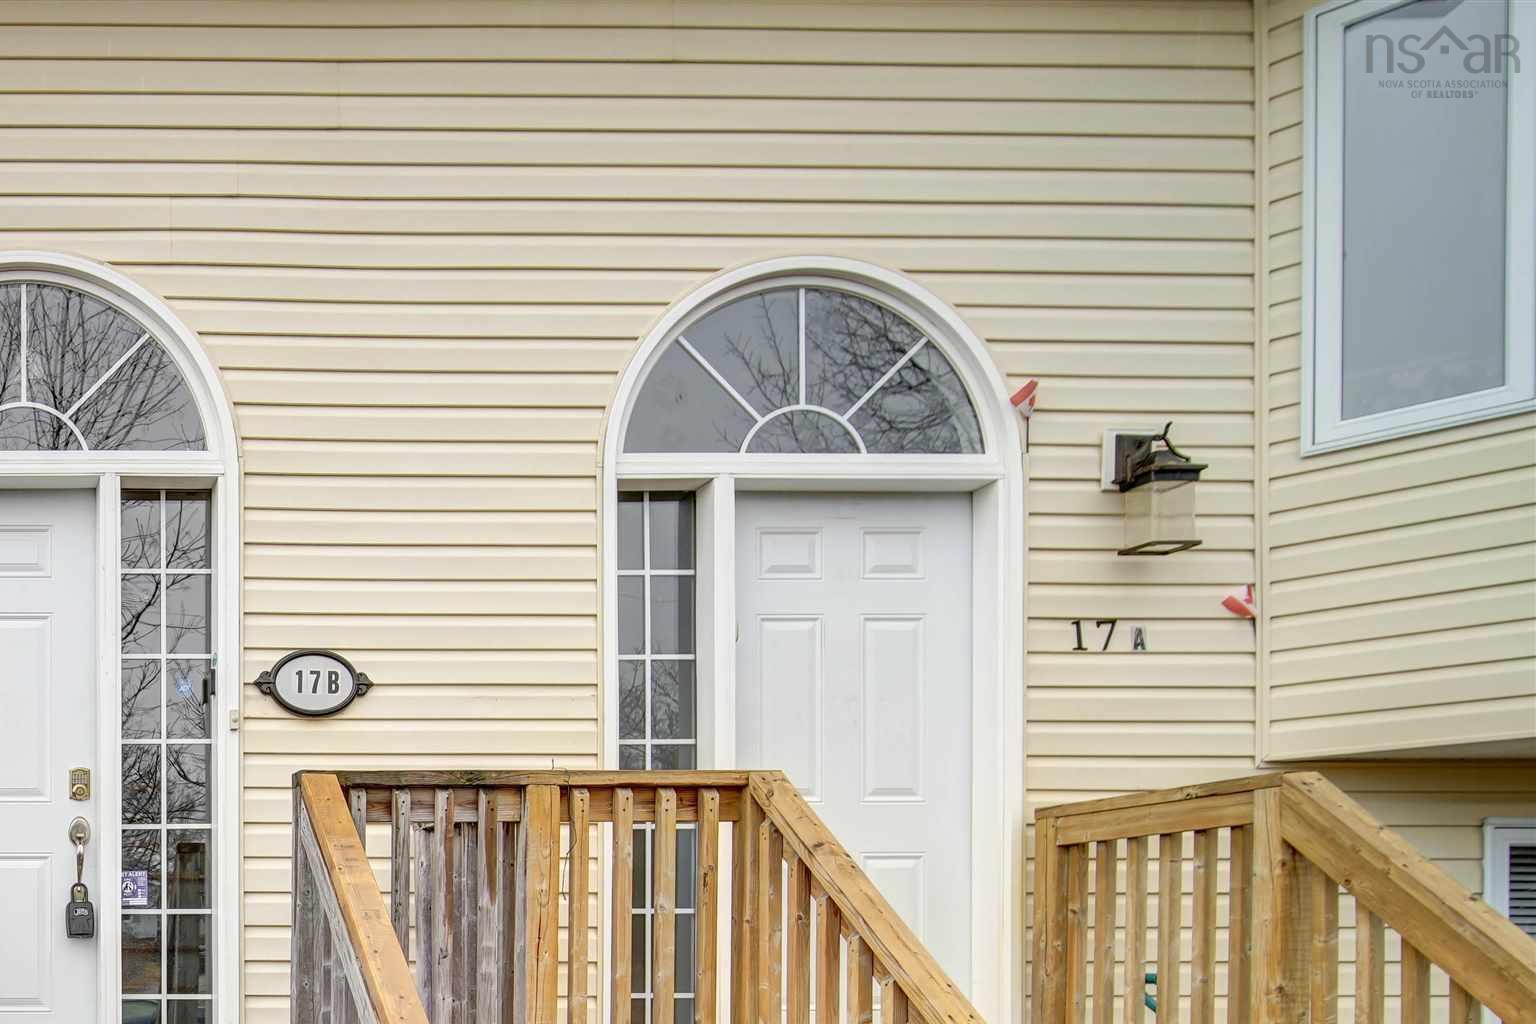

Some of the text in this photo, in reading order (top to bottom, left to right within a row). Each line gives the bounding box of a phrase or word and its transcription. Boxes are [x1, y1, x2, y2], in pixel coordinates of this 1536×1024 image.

[1071, 618, 1146, 651] 17 A
[296, 670, 339, 694] 17B
